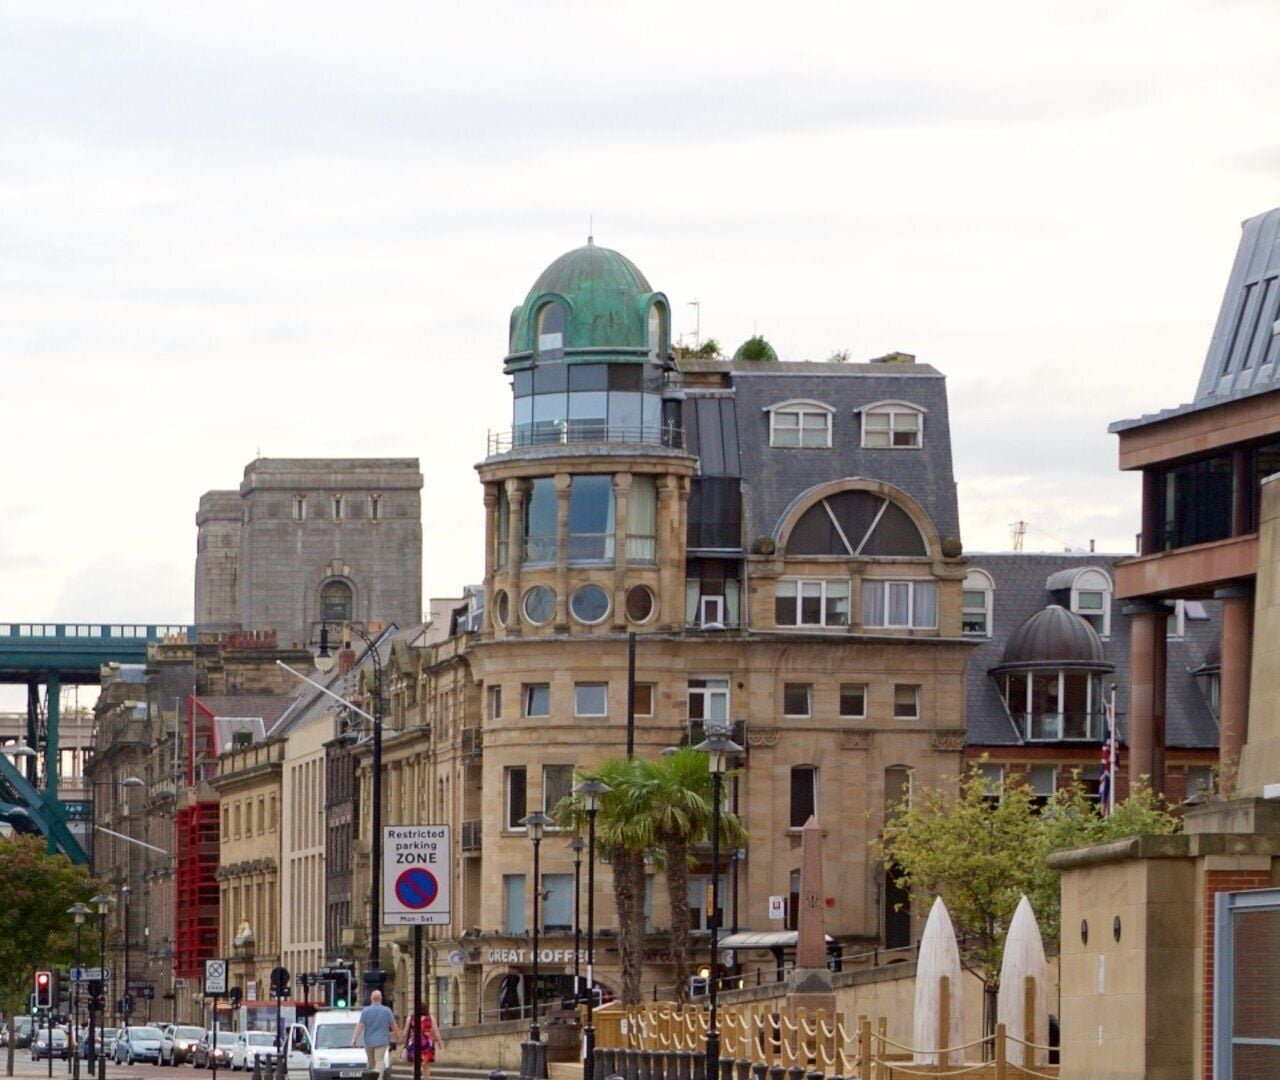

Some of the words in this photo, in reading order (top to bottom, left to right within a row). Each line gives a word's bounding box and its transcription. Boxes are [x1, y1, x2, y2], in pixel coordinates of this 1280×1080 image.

[388, 830, 445, 839] Restricted
[395, 841, 437, 851] parking
[396, 853, 437, 864] ZONE
[488, 949, 526, 962] GREAT
